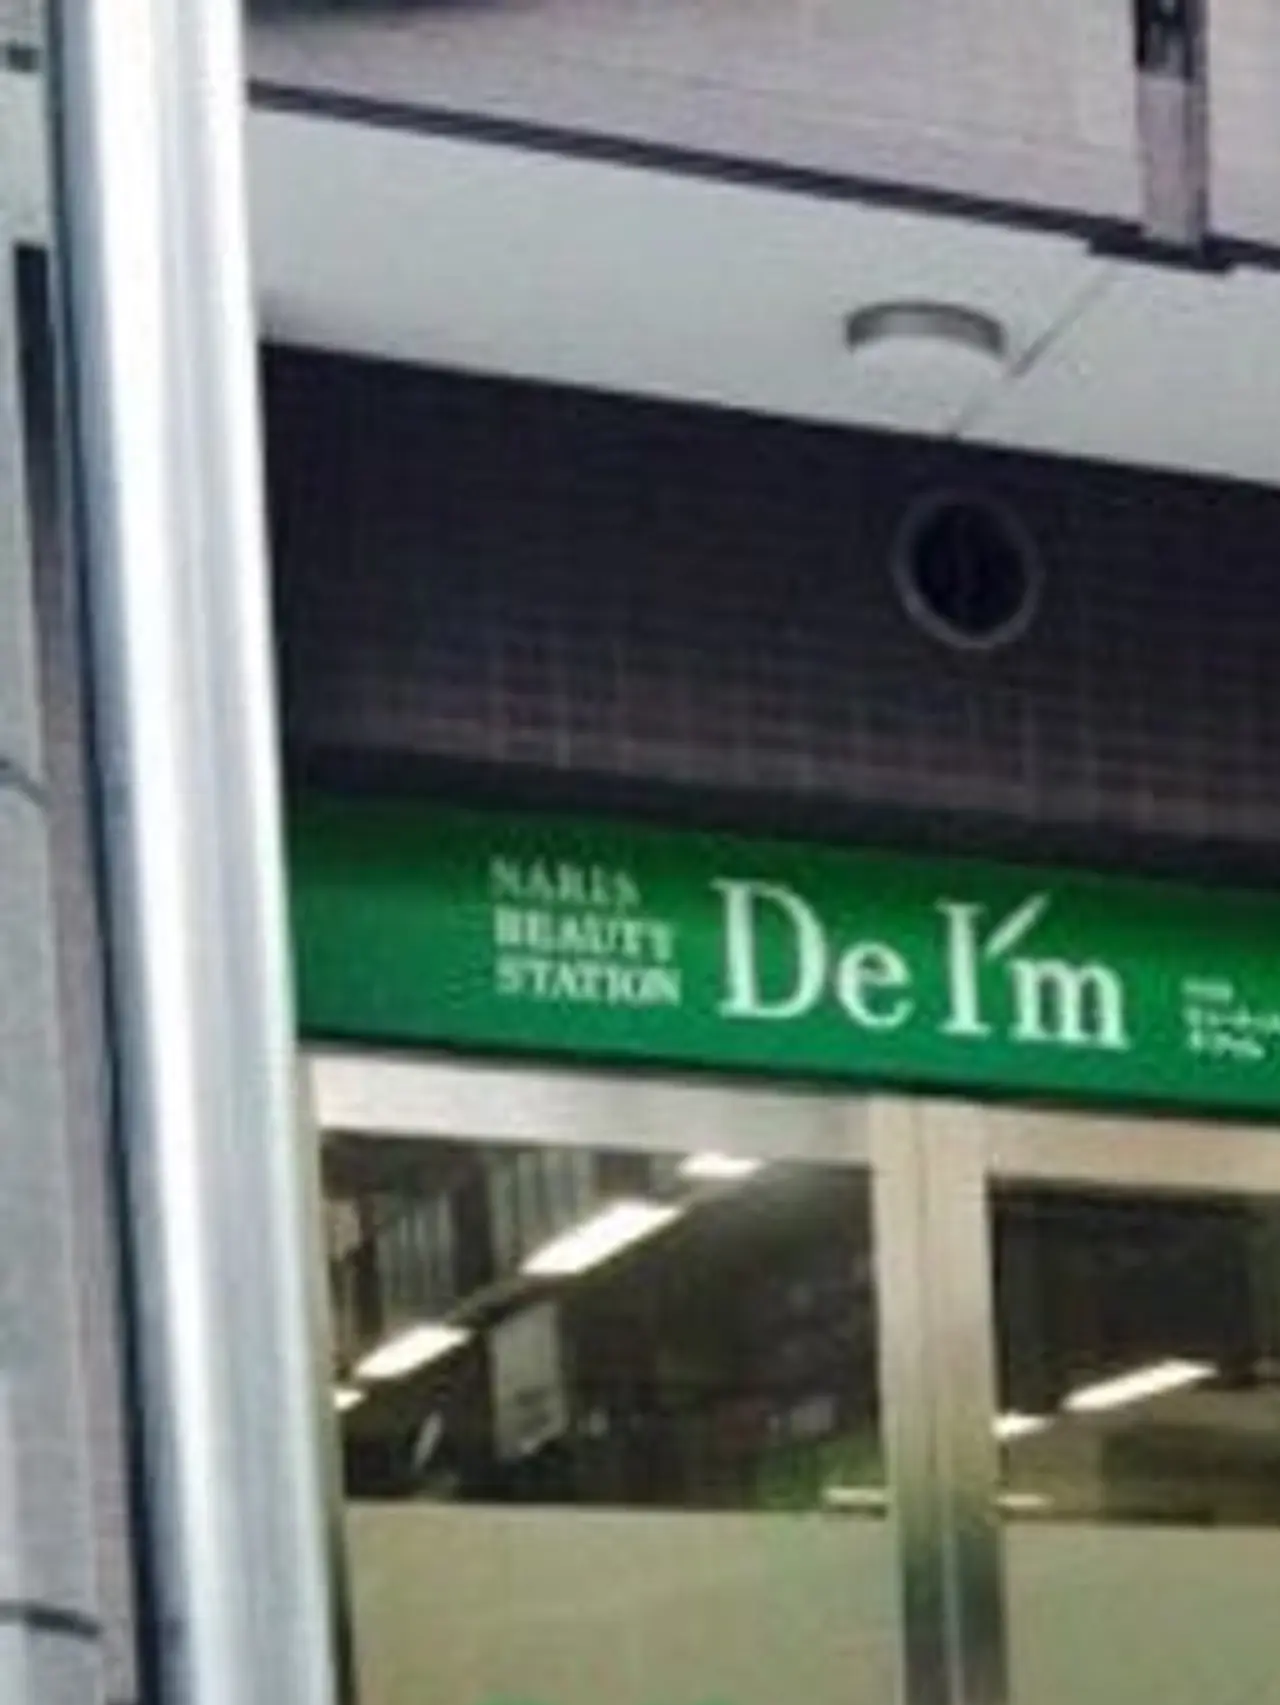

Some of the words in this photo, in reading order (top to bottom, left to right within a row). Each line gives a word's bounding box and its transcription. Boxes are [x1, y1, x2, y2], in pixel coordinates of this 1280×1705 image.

[489, 856, 642, 908] NARIS
[493, 904, 676, 963] BEAUTY
[495, 954, 685, 1008] STATION
[711, 876, 914, 1031] De
[934, 892, 1131, 1051] I'm
